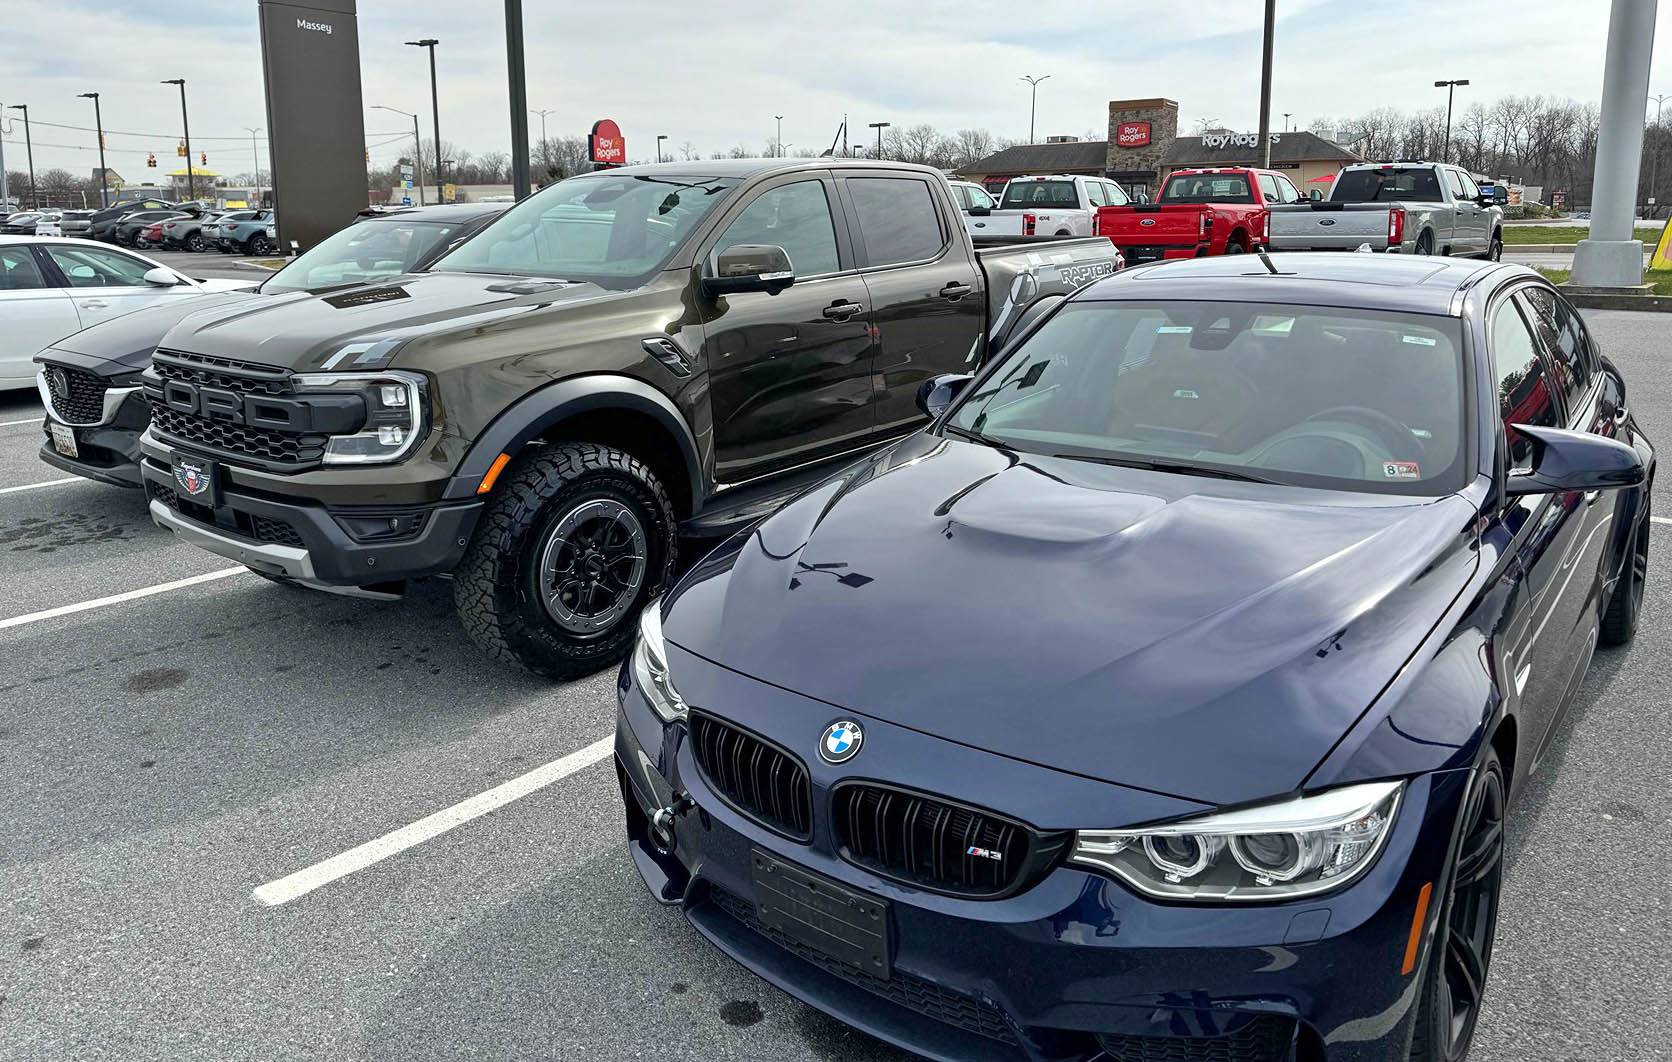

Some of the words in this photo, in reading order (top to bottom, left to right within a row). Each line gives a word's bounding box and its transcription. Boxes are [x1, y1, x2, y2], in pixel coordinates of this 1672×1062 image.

[296, 18, 332, 35] Massey
[1124, 127, 1139, 135] Roy
[1120, 132, 1146, 142] Rogers
[1202, 134, 1230, 149] Roy
[1230, 133, 1281, 148] Rogs
[600, 138, 613, 149] Roy
[596, 148, 620, 159] Rogers
[1059, 262, 1113, 288] RAPTOR
[1387, 465, 1396, 475] 8
[832, 722, 861, 740] BMW
